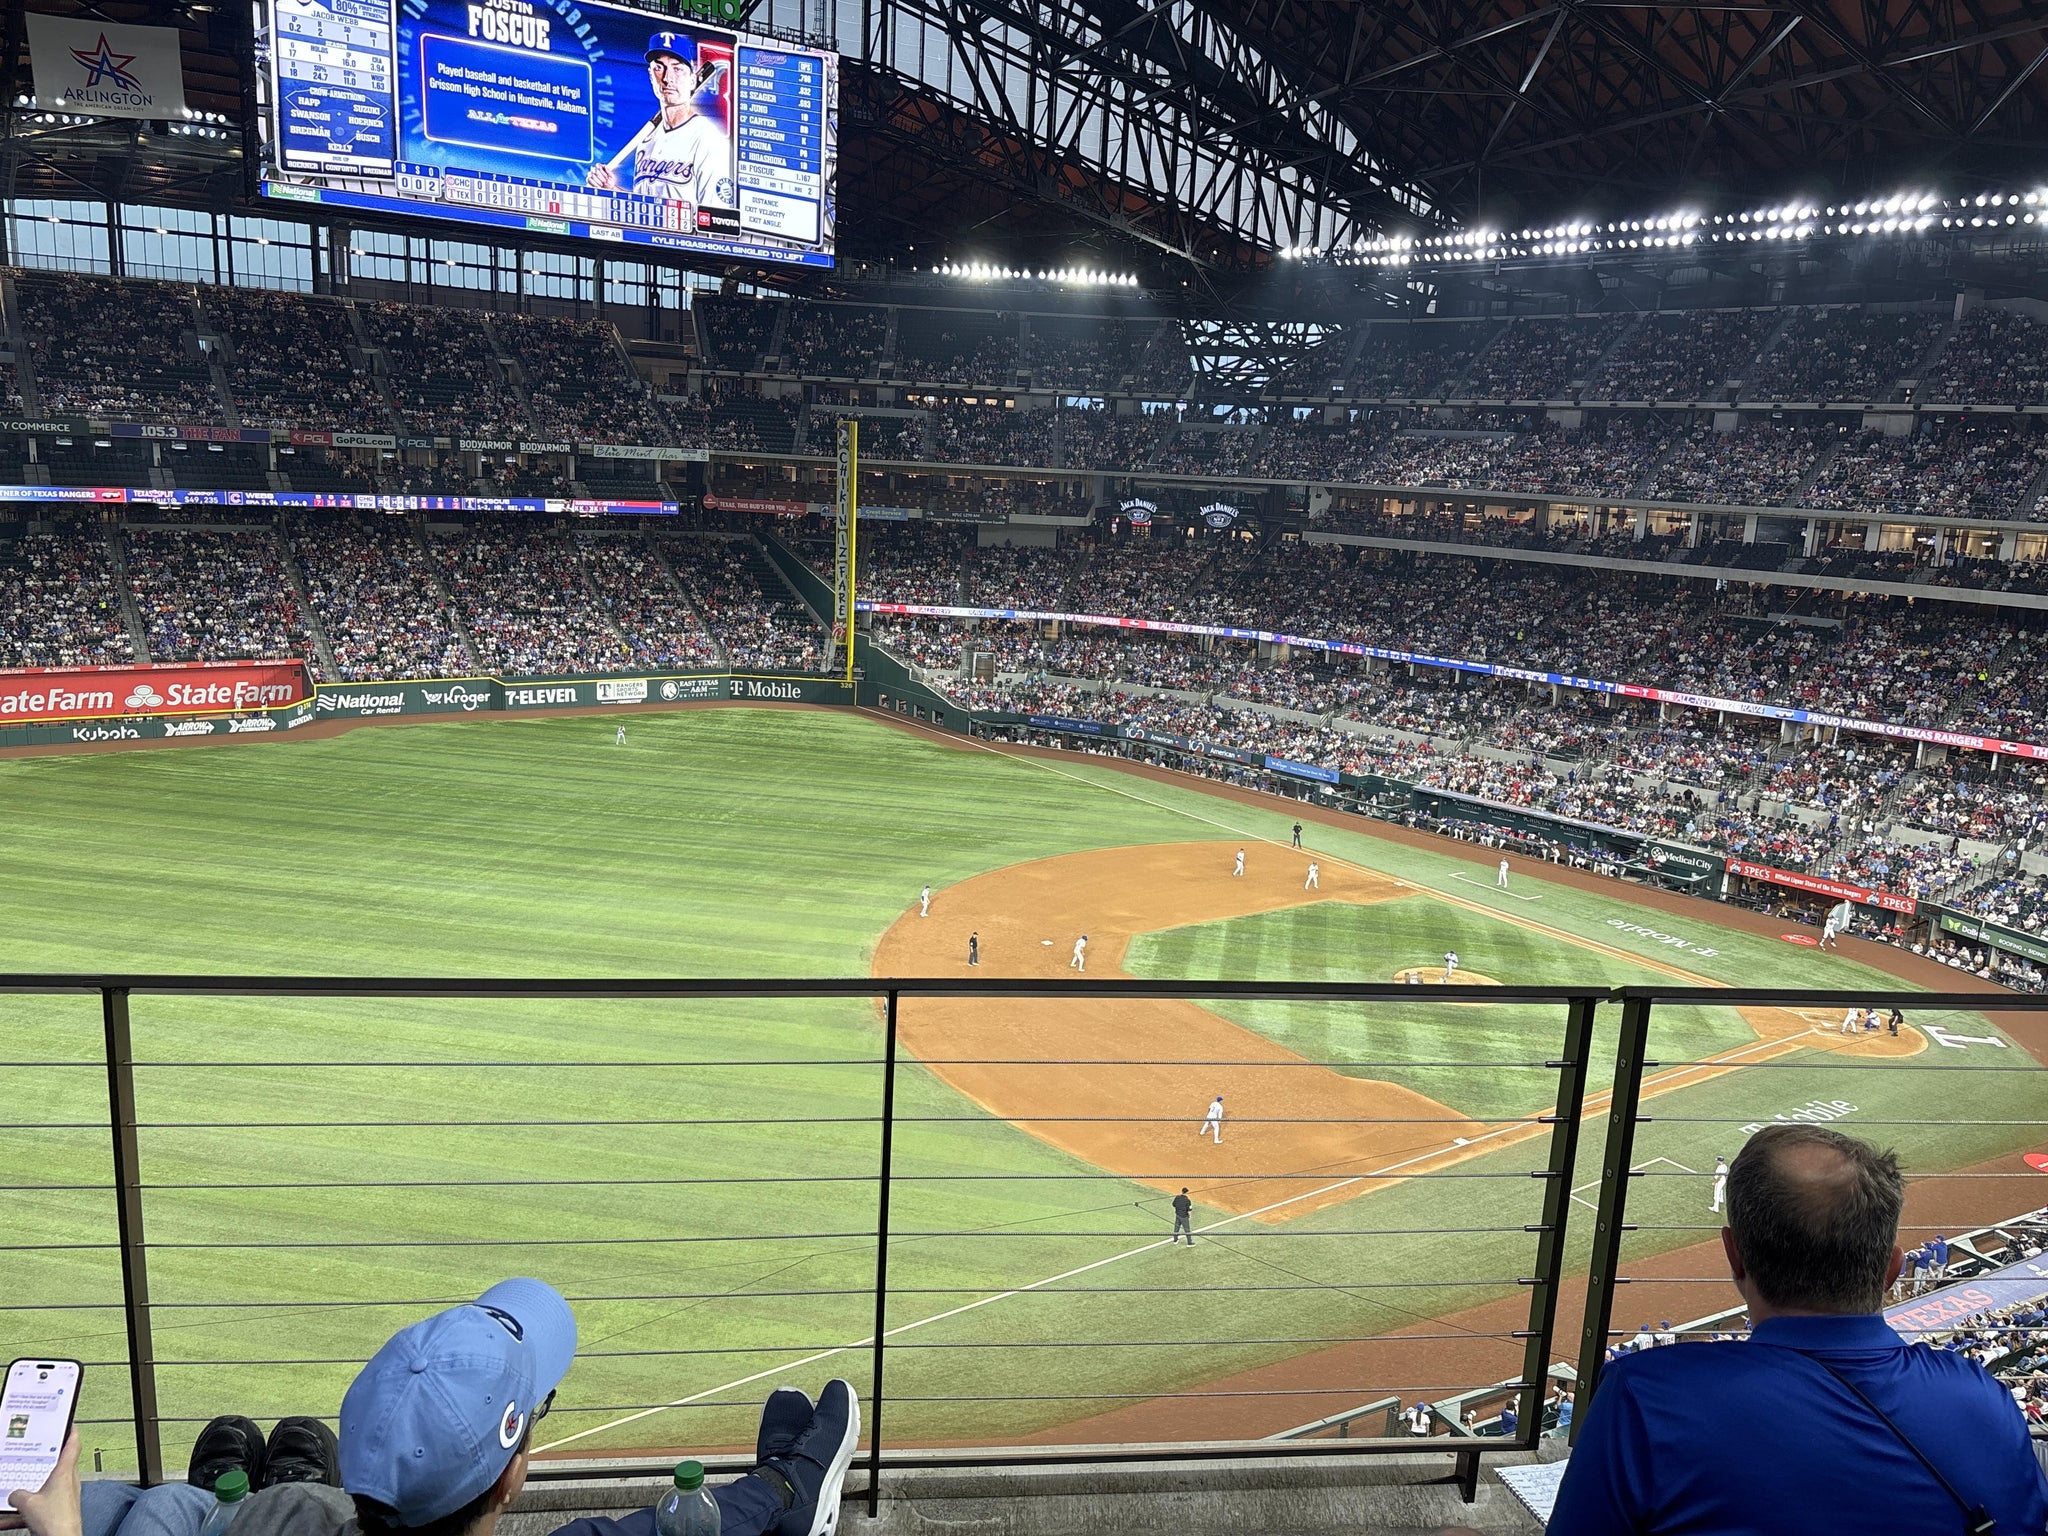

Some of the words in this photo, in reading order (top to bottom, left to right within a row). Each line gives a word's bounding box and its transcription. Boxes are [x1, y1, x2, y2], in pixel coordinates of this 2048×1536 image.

[312, 10, 335, 21] JACOB
[338, 16, 358, 26] WEBB
[289, 22, 301, 32] 0.2
[468, 4, 550, 50] FOSCUE
[660, 32, 675, 48] T
[289, 50, 296, 58] 17
[342, 59, 356, 68] 16.0
[370, 64, 384, 72] 3.94
[750, 66, 774, 77] NIMMO
[313, 72, 328, 81] 24.7
[344, 77, 356, 86] 11.0
[372, 82, 384, 90] 1.63
[438, 63, 463, 78] Played
[465, 69, 496, 84] baseball
[498, 74, 512, 86] and
[514, 77, 550, 92] basketball
[552, 85, 560, 94] at
[561, 86, 580, 100] Virgil
[750, 79, 773, 90] DURAN
[64, 87, 152, 106] ARLINGTON
[310, 87, 366, 102] CROW-ARMSTRONG
[430, 78, 462, 92] Grissom
[464, 83, 481, 97] High
[482, 86, 507, 101] School
[508, 92, 516, 102] in
[518, 93, 555, 110] Huntsville,
[556, 101, 588, 116] Alabama.
[750, 92, 776, 102] SEAGER
[298, 96, 320, 106] HAPP
[353, 104, 380, 115] SUZUKI
[596, 75, 615, 128] TIME
[750, 104, 768, 114] JUNG
[290, 109, 330, 121] SWANSON
[348, 116, 384, 128] HOERNER
[750, 116, 776, 128] CARTER
[290, 126, 330, 137] BREGMAN
[356, 133, 380, 142] BUSCH
[750, 129, 785, 141] PEDERSON
[328, 142, 352, 152] KELLY
[750, 140, 772, 152] OSUNA
[401, 164, 406, 172] B
[749, 166, 774, 176] FOSCUE
[402, 177, 408, 188] 0
[416, 179, 422, 190] 0
[429, 181, 435, 192] 2
[454, 178, 470, 188] CHC
[282, 186, 316, 196] National
[456, 190, 470, 200] TEX
[752, 196, 778, 208] DISTANCE
[744, 206, 757, 214] EXIT
[758, 208, 785, 218] VELOCITY
[712, 216, 739, 227] TOYOTA
[748, 216, 762, 224] EXIT
[763, 219, 782, 228] ANGLE
[652, 236, 675, 246] KYLE
[676, 238, 732, 252] HIGASHIOKA
[732, 246, 770, 257] SINGLED
[771, 250, 783, 258] TO
[784, 253, 804, 261] LEFT
[0, 422, 8, 430] Y
[11, 422, 70, 432] COMMERCE
[141, 426, 177, 438] 105.3
[181, 427, 209, 439] THE
[212, 428, 240, 440] FAN
[303, 435, 329, 444] PGL
[336, 436, 392, 446] GoPGL.com
[407, 439, 432, 448] PGL
[460, 439, 512, 450] BODYARMOR
[520, 442, 570, 452] BODYARMOR
[596, 446, 622, 458] Blue
[624, 448, 654, 458] Mint
[838, 451, 848, 526] CHIKIN
[184, 496, 218, 504] $49,235
[1120, 502, 1134, 512] JACK
[1135, 498, 1158, 513] DANIEL'S
[1200, 504, 1214, 516] JACK
[1216, 502, 1239, 518] DANIEL'S
[838, 565, 848, 616] FARE
[1093, 616, 1120, 625] RANGERS
[1160, 623, 1189, 632] ALL-NEW
[748, 681, 801, 699] Mobile
[336, 692, 405, 709] National
[445, 686, 490, 711] Kroger
[1656, 690, 1675, 700] THE
[1675, 694, 1716, 707] ALL-NEW
[1741, 704, 1764, 714] RAV4
[177, 722, 206, 730] ARROW
[242, 718, 269, 728] ARROW
[288, 714, 314, 728] HONDA
[72, 726, 140, 742] Kubota
[1806, 712, 1841, 728] PROUD
[1842, 718, 1885, 734] PARTNER
[1886, 724, 1901, 735] OF
[1902, 727, 1934, 740] TEXAS
[1934, 732, 1984, 748] RANGERS
[1150, 734, 1174, 744] American
[1210, 748, 1236, 758] American
[1488, 809, 1516, 818] CHOCTAW
[1524, 816, 1552, 826] CHOCTAW
[1560, 825, 1590, 836] CHOCTAW
[1664, 852, 1696, 867] Medical
[1698, 857, 1713, 872] City
[1744, 866, 1771, 880] SPEC'S
[1774, 873, 1790, 882] Official
[1830, 886, 1842, 894] Texas
[1843, 889, 1862, 899] Rangers
[1882, 896, 1913, 912] SPEC'S
[1606, 918, 1696, 949] Mobile
[1962, 924, 1990, 941] DaBella
[1998, 938, 2022, 951] ROOFING
[1888, 1287, 1994, 1332] TEXAS
